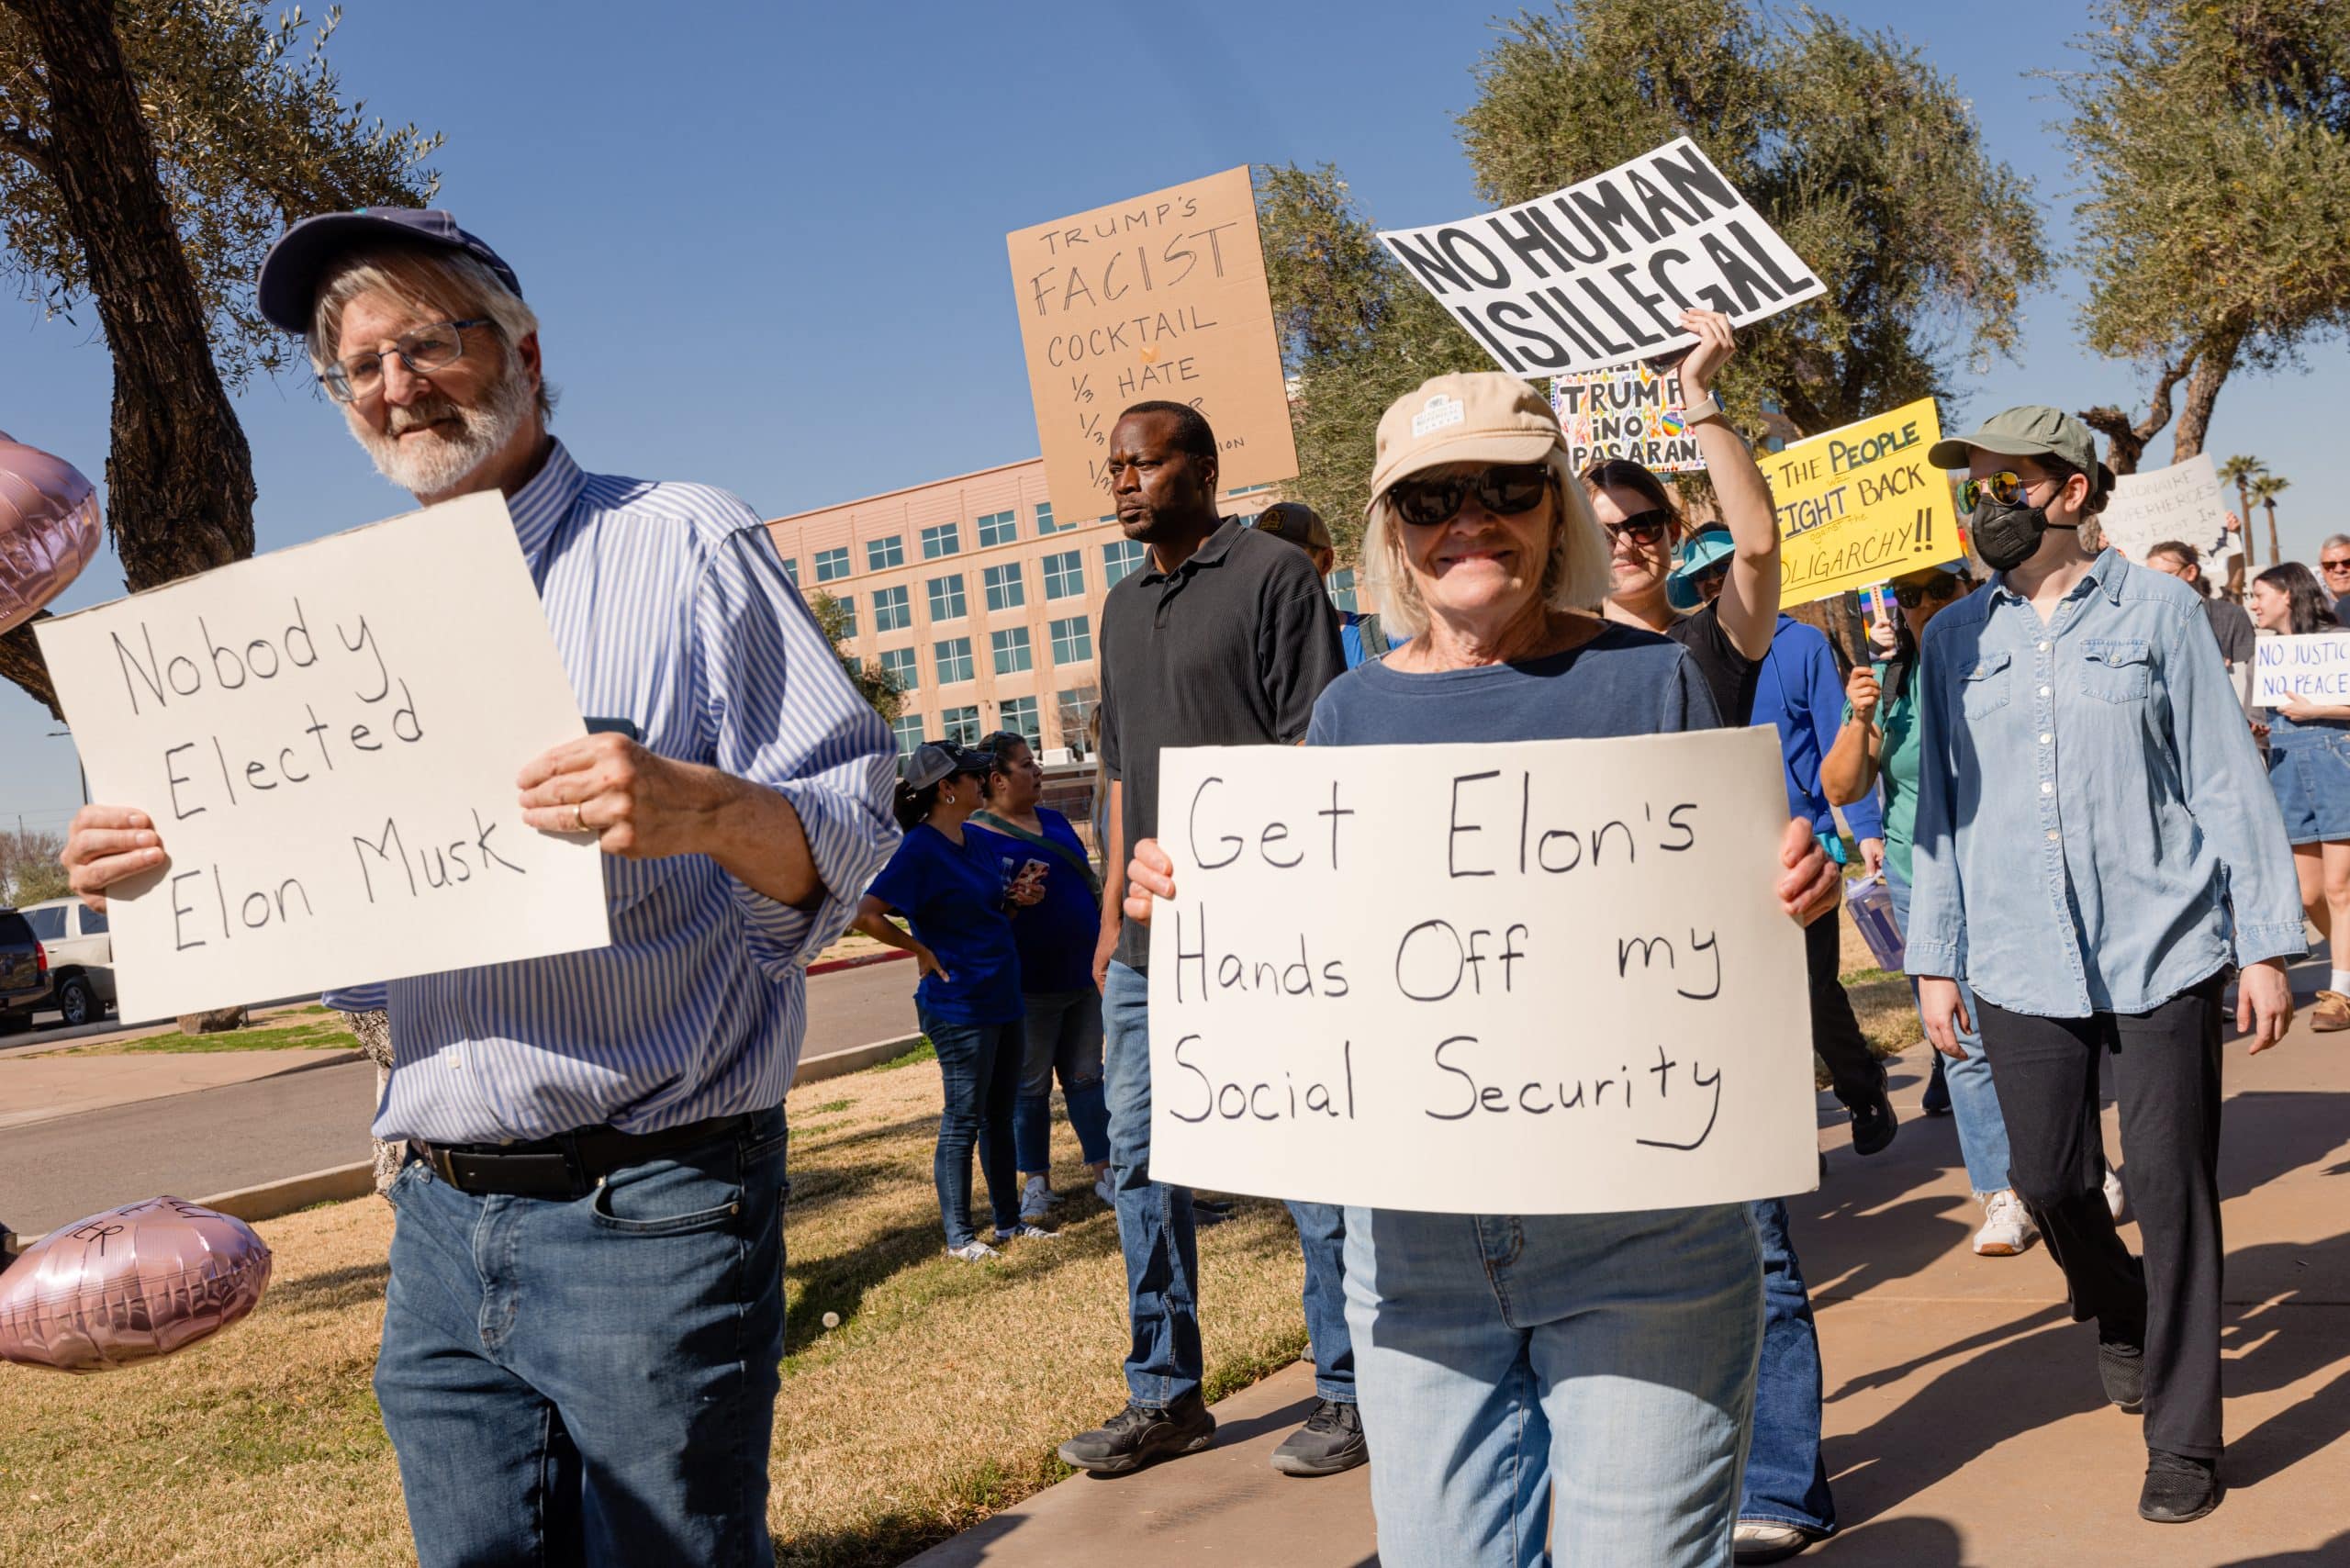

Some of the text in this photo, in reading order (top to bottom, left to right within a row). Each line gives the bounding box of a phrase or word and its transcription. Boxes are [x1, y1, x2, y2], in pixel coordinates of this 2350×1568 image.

[1039, 196, 1198, 255] TRUMP'S
[1387, 144, 1740, 295] NO HUMAN
[1030, 222, 1237, 317] FACIST
[1048, 306, 1217, 367] COCKTAIL
[1071, 357, 1200, 403] 1/3 HATE
[1779, 456, 1822, 487] THE
[1829, 420, 1920, 474] PEOPLE
[1858, 463, 1926, 507] BACK
[111, 597, 390, 715] Nobody
[2259, 641, 2349, 666] NO JUSTIC
[2263, 673, 2348, 696] NO PEACE
[165, 678, 423, 821] Elected
[1190, 770, 1697, 879] Get Elon's
[171, 808, 526, 951] Elon Musk
[1175, 902, 1721, 1003] Hands Off my
[1170, 1035, 1721, 1150] Social Security
